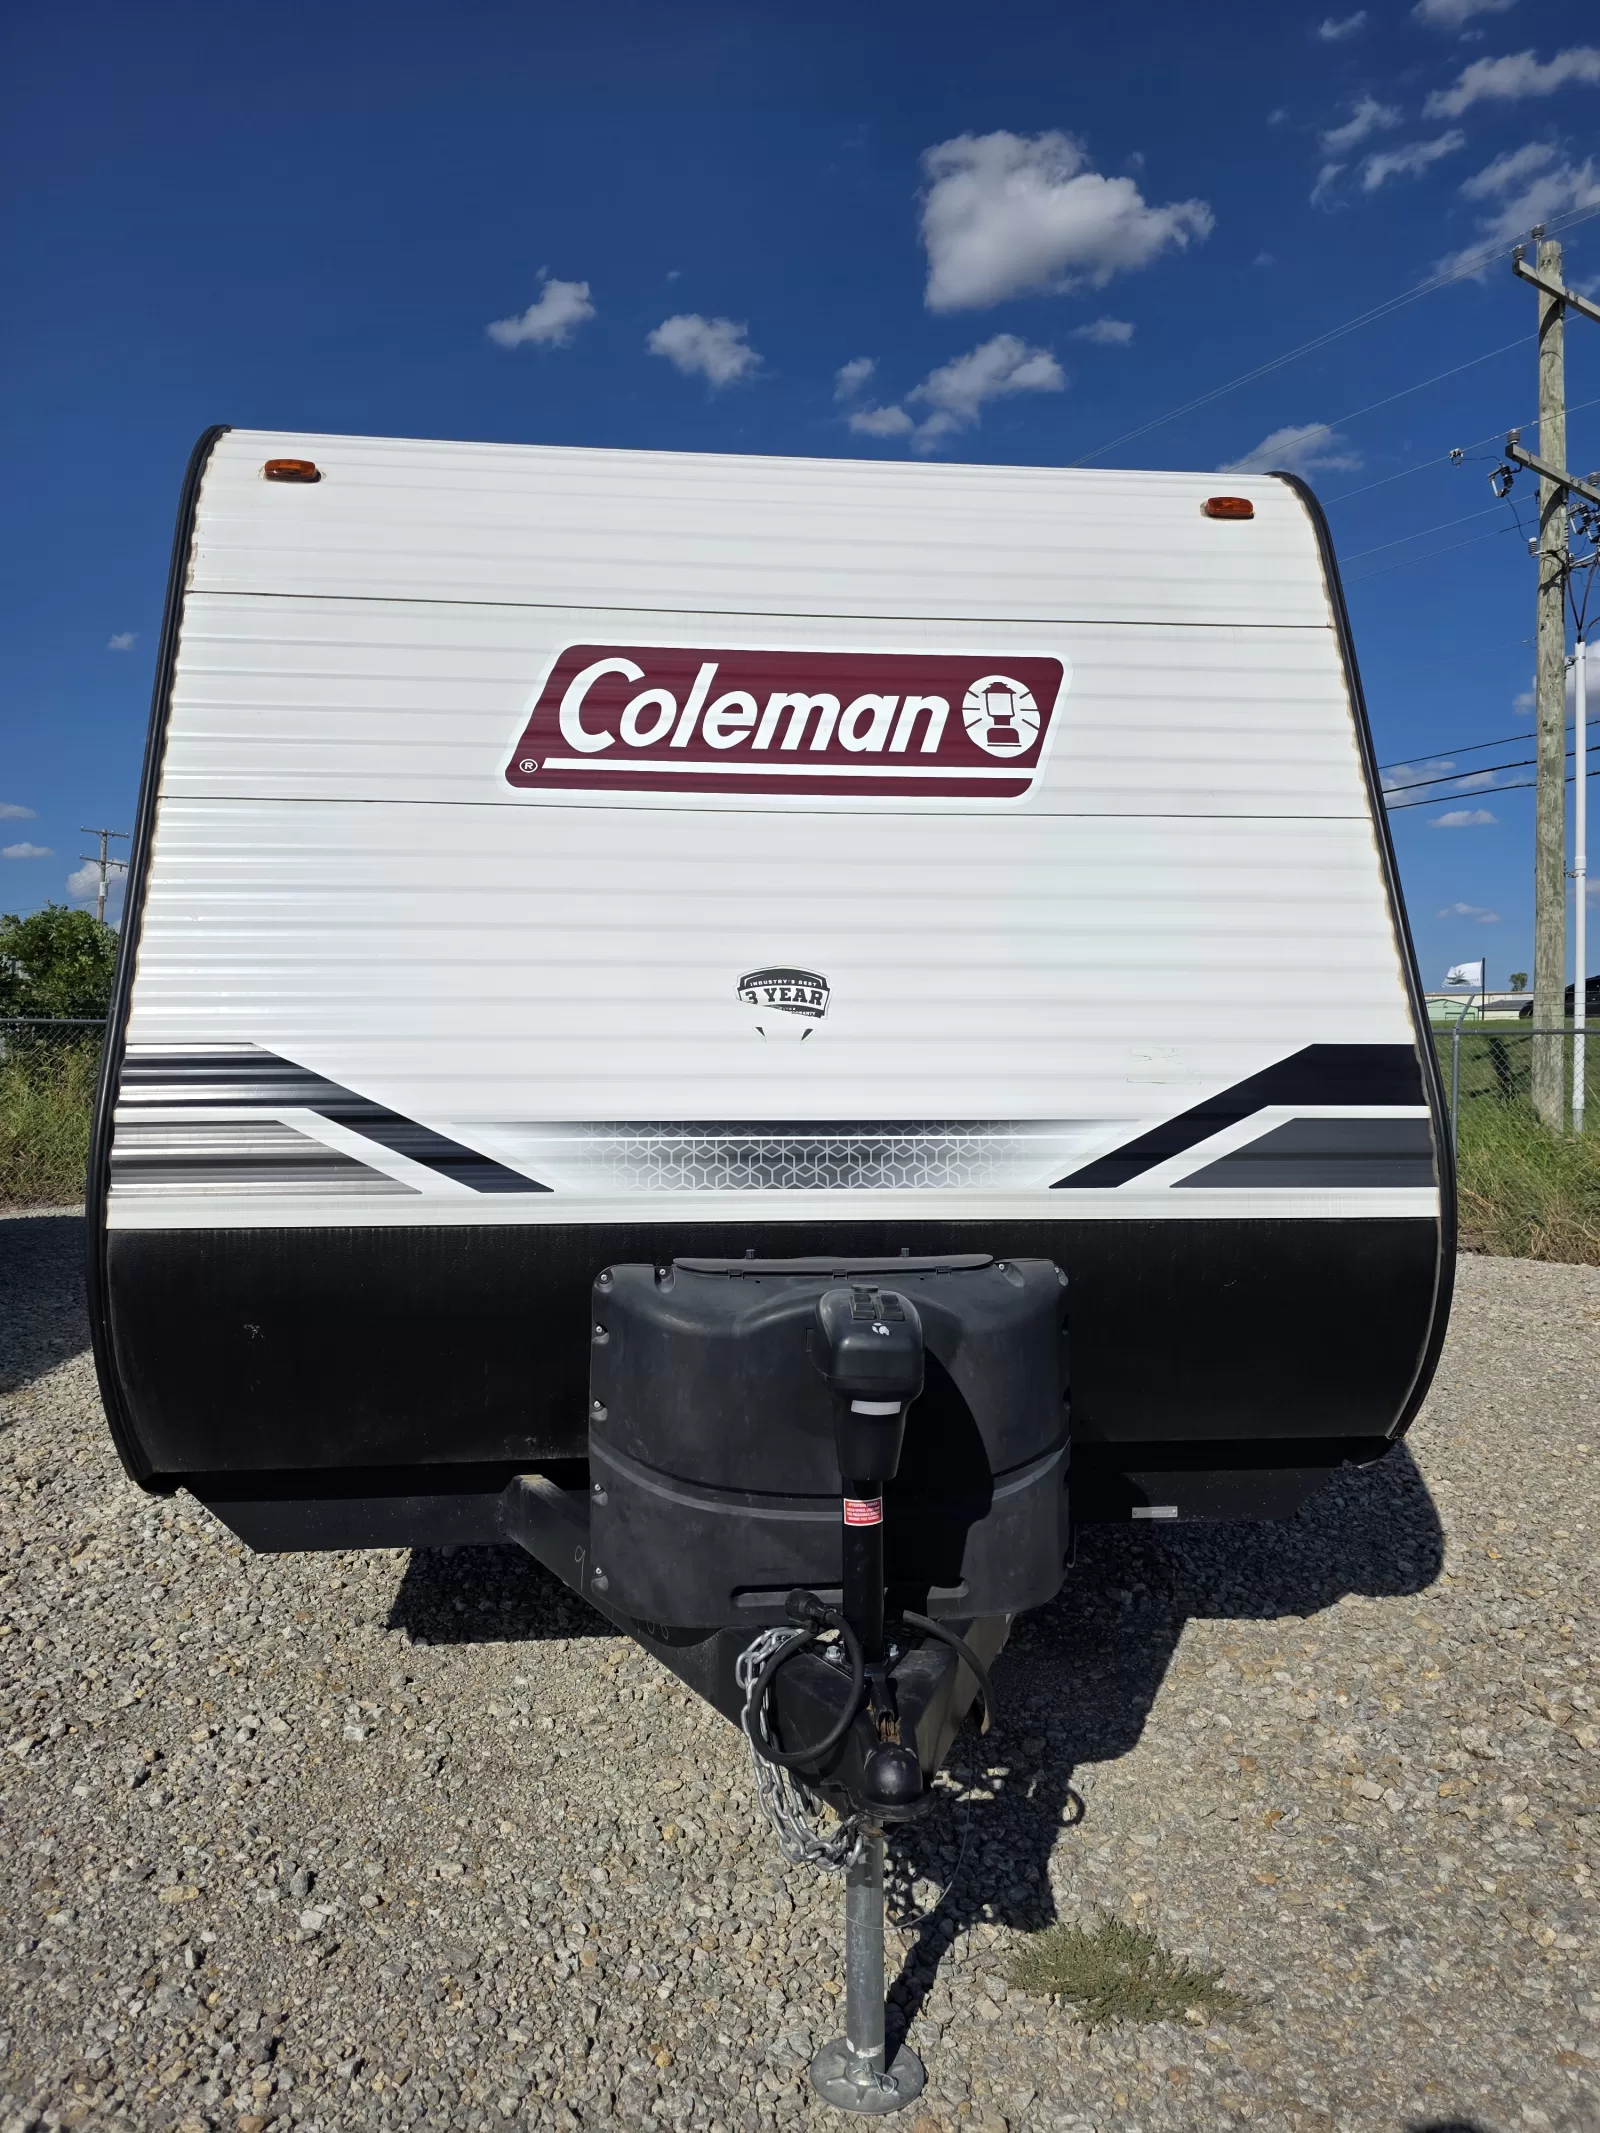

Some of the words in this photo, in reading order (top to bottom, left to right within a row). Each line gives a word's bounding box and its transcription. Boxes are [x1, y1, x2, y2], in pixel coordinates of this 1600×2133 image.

[558, 657, 949, 753] Coleman
[749, 979, 796, 987] INDUSTRY'S
[745, 990, 758, 1005] 3
[763, 987, 823, 1006] YEAR
